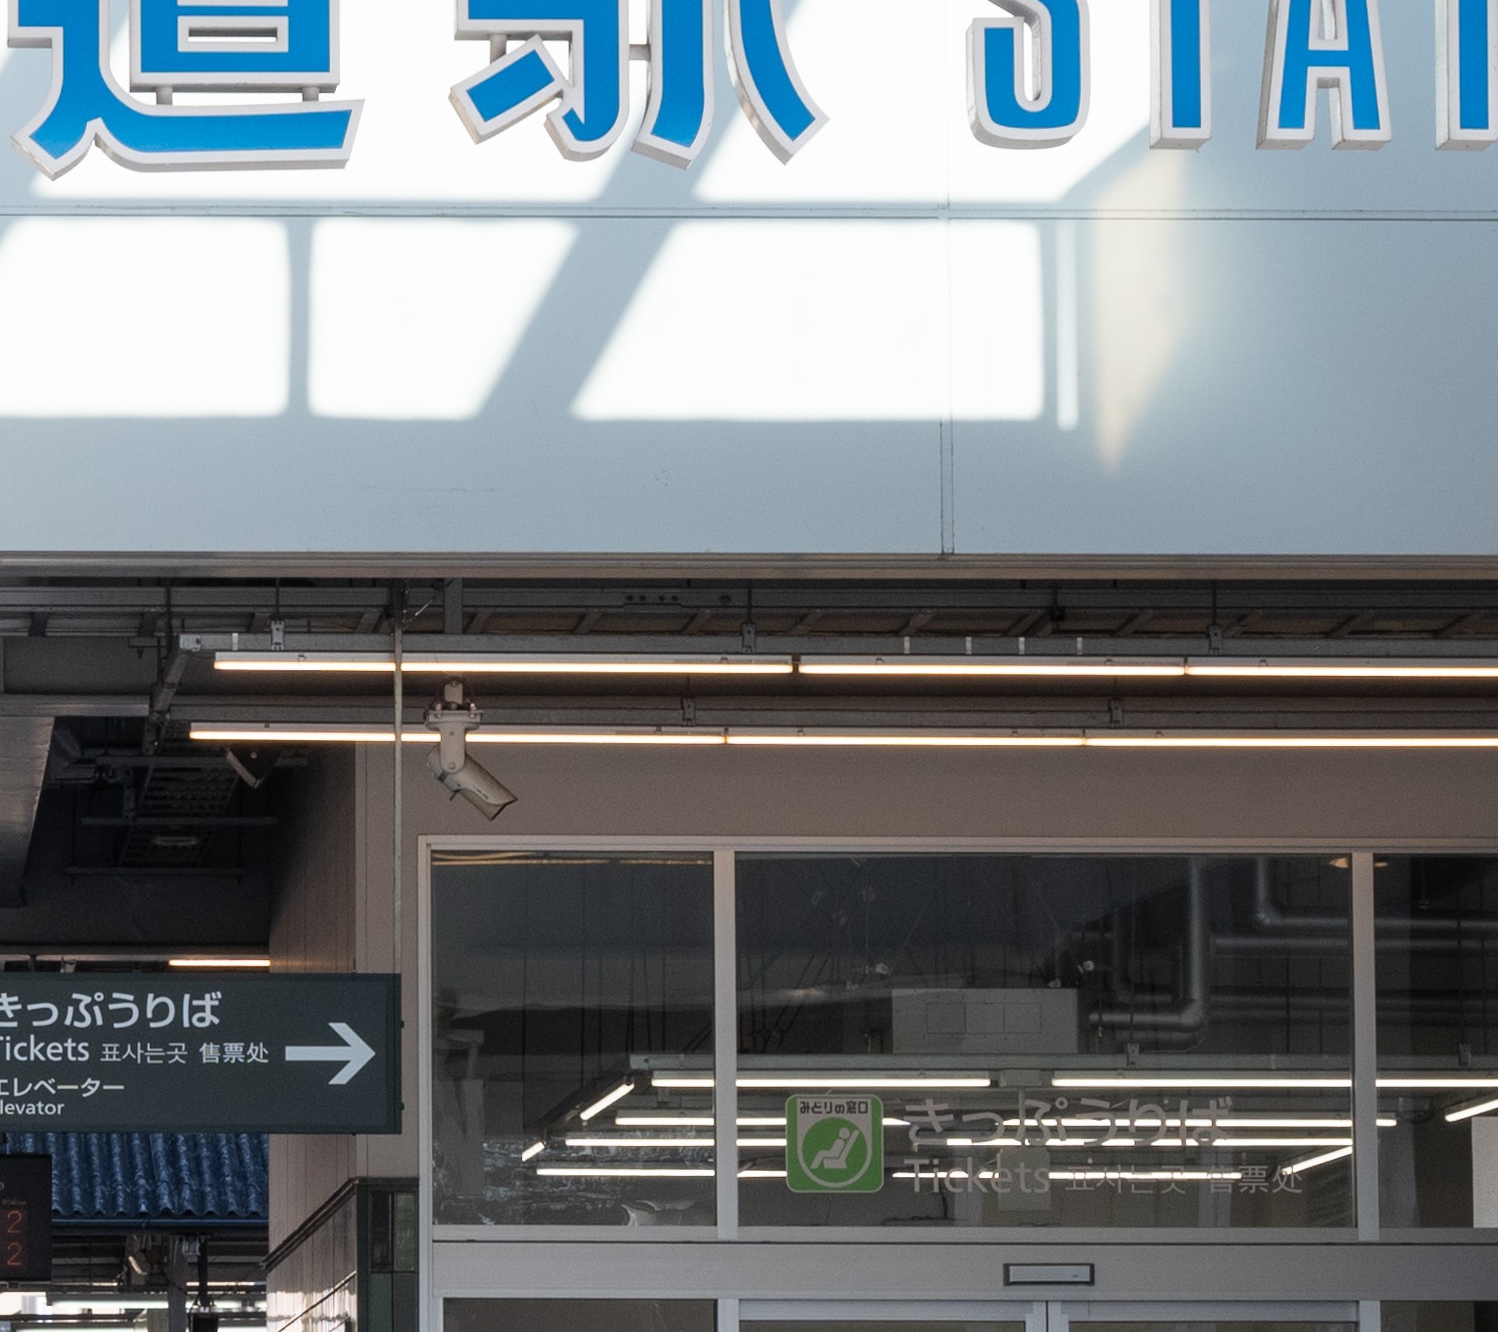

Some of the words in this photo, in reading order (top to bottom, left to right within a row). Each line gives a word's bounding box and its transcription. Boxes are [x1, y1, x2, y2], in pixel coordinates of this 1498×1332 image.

[100, 1042, 188, 1065] 표사는곳
[199, 1042, 270, 1065] 售票处
[798, 1100, 870, 1116] みどりの窓口
[905, 1094, 1235, 1151] きっぷうりば
[902, 1155, 1053, 1196] Tickets
[6, 1210, 23, 1234] 2
[6, 1242, 23, 1266] 2
